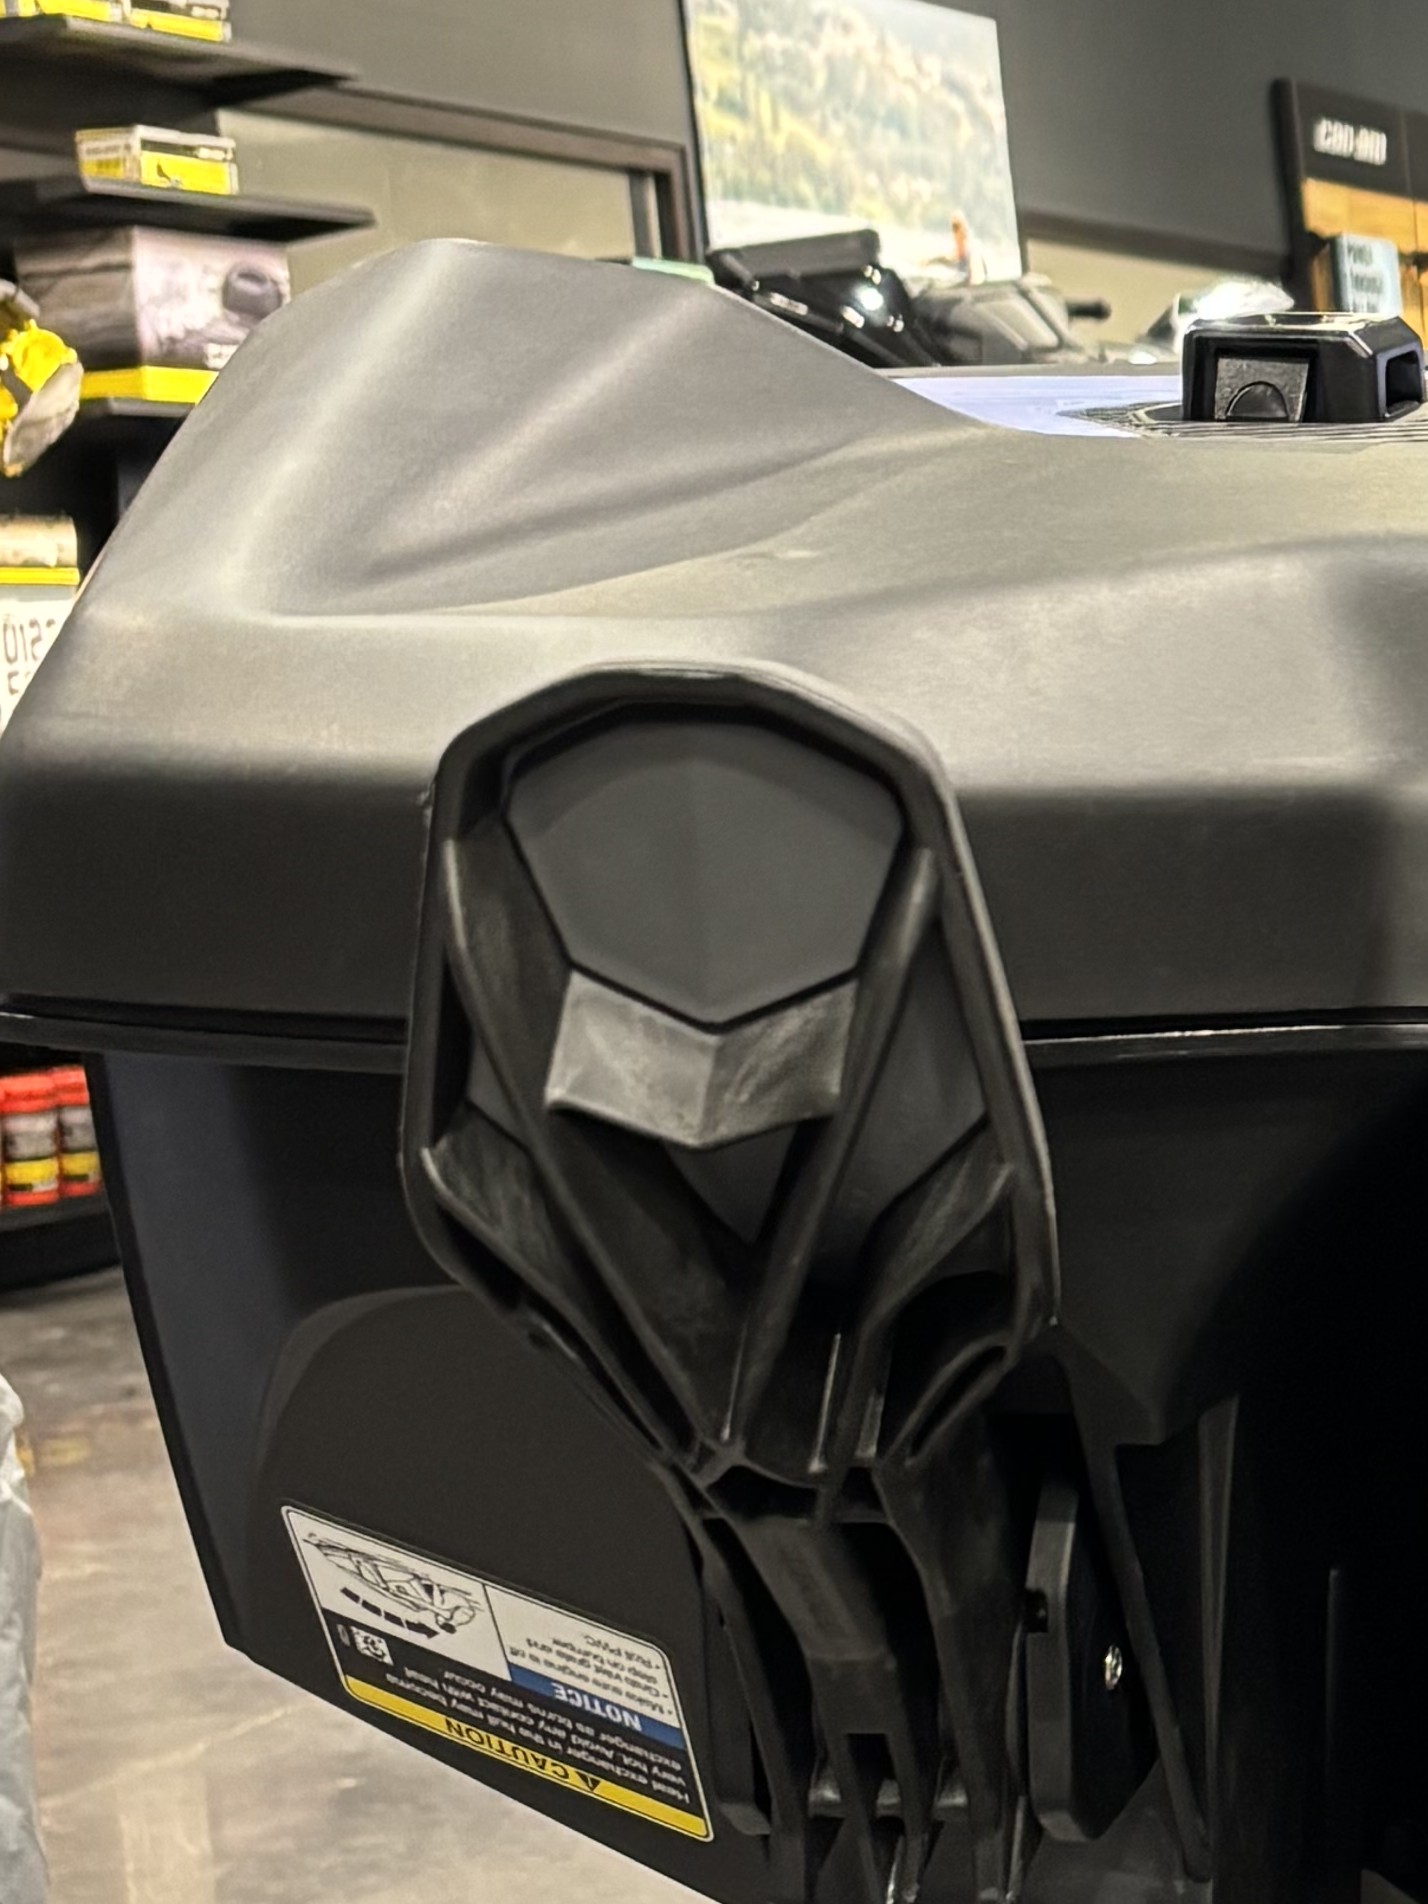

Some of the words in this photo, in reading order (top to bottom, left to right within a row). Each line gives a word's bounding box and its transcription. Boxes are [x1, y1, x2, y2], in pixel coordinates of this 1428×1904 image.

[448, 1695, 484, 1721] may
[487, 1684, 524, 1709] may
[550, 1681, 642, 1731] NOTICE
[525, 1701, 574, 1730] burns
[534, 1716, 567, 1740] any
[442, 1716, 570, 1781] CAUTION
[568, 1731, 615, 1761] Avoid
[649, 1763, 686, 1787] very
